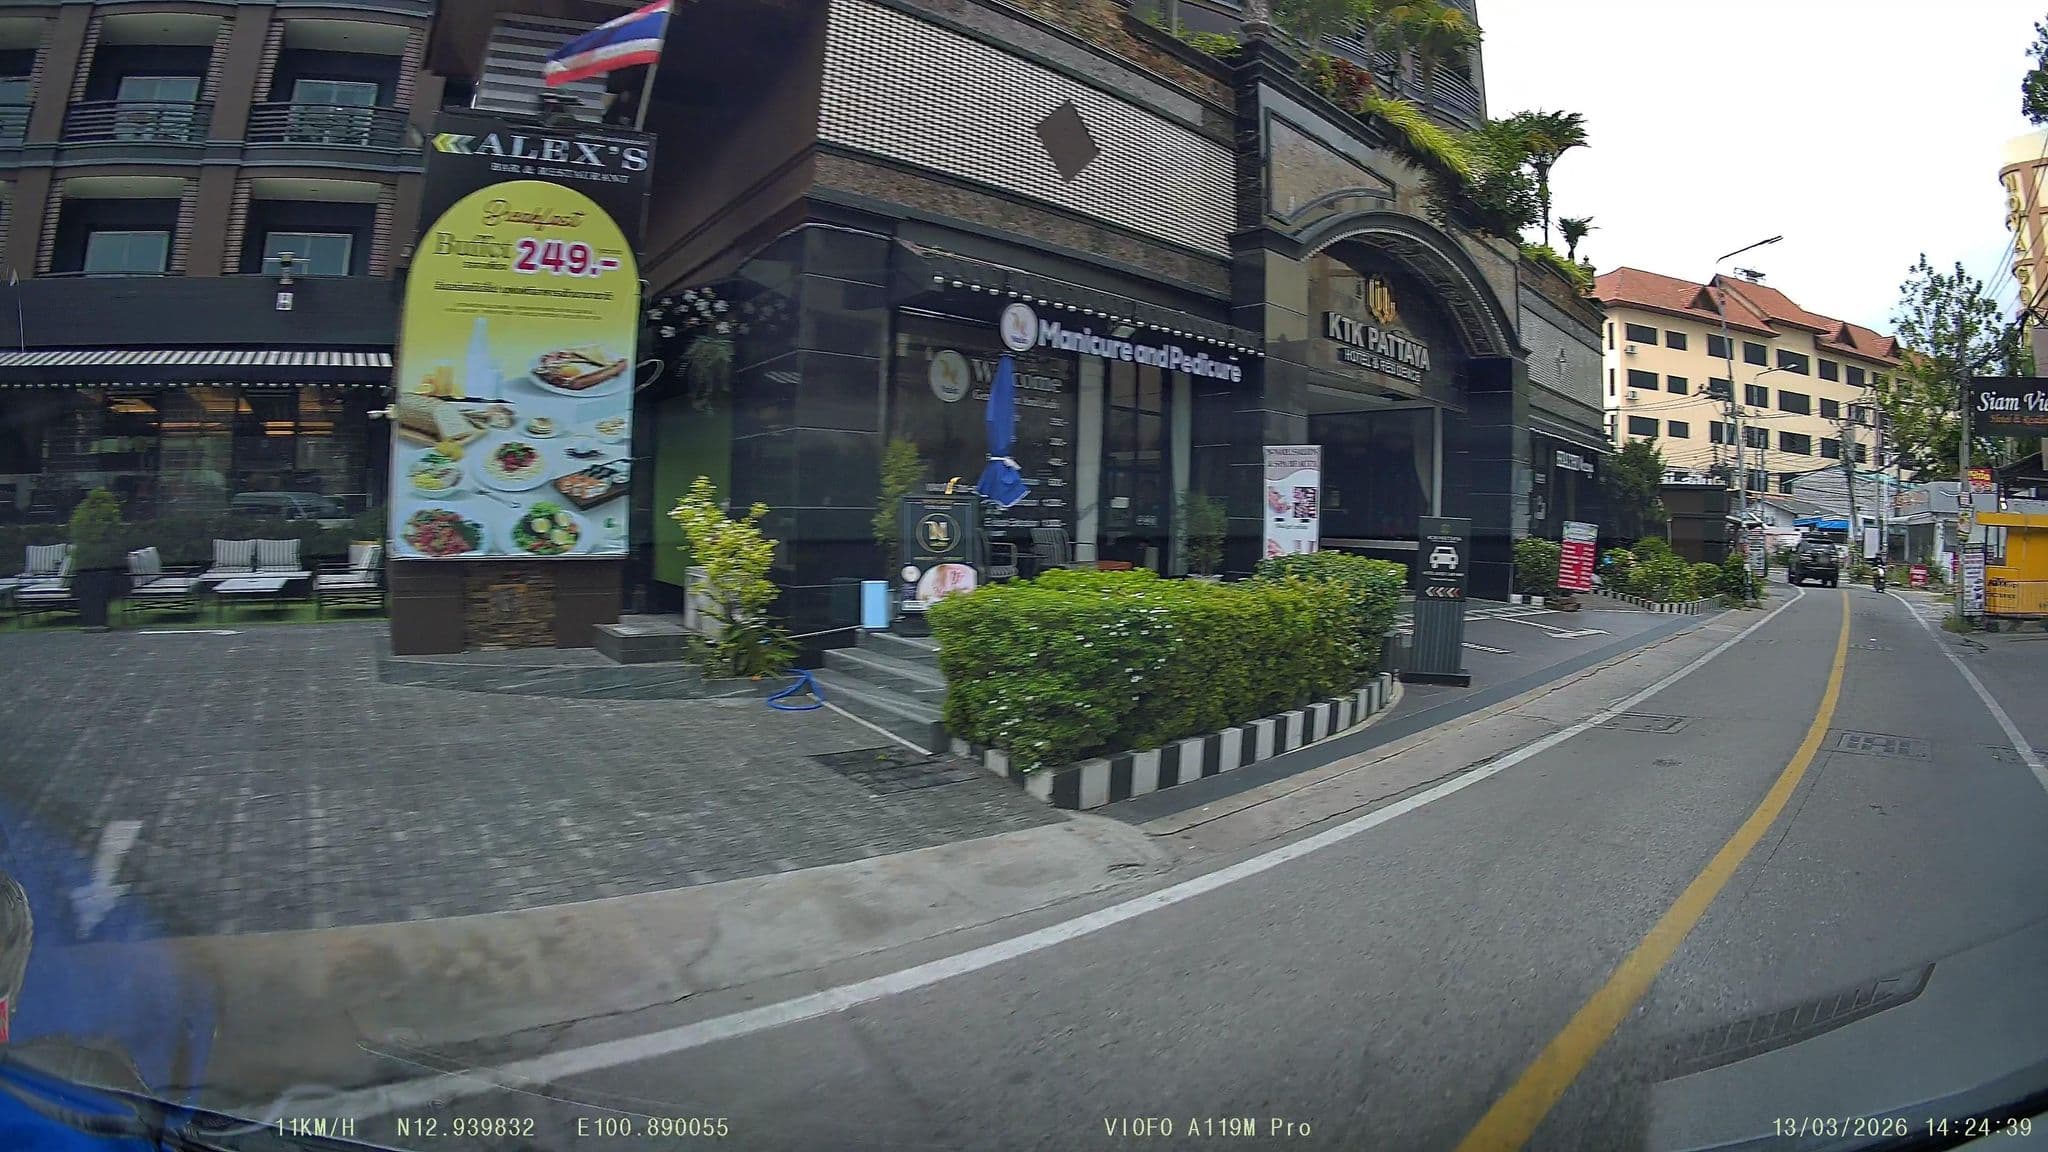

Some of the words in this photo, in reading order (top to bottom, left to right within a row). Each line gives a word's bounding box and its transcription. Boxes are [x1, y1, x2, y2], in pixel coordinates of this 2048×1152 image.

[472, 131, 649, 172] ALEX'S
[1037, 317, 1133, 362] Manicure
[1133, 344, 1169, 369] and
[1169, 345, 1243, 383] Pedicure
[1328, 311, 1365, 347] KTK
[1367, 325, 1431, 371] PATTAYA
[1343, 348, 1372, 368] HOTEL
[1976, 391, 2021, 412] Siam
